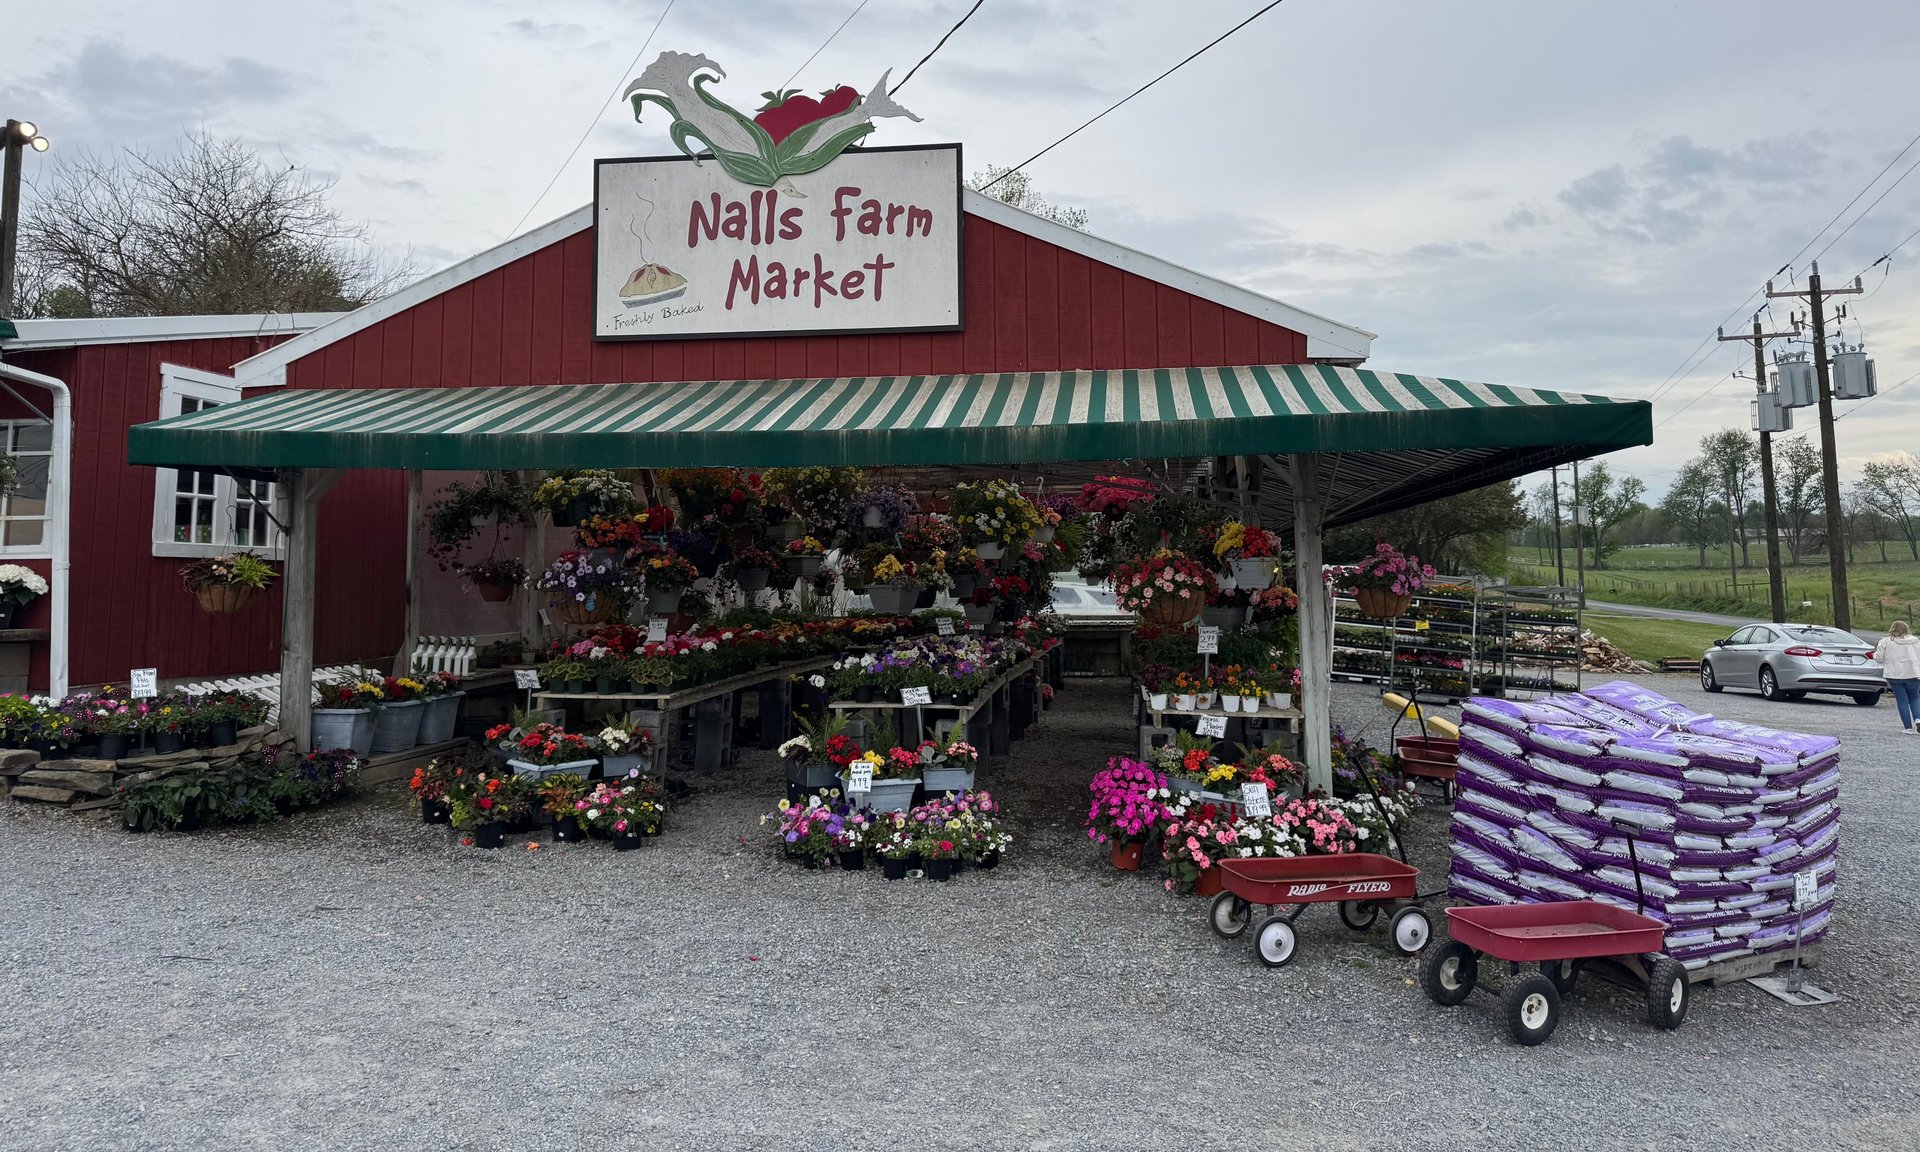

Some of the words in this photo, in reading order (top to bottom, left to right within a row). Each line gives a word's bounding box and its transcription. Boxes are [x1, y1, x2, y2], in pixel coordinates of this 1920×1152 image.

[687, 188, 804, 249] Nalls
[725, 252, 895, 310] Market
[612, 311, 654, 330] Freshly
[661, 300, 704, 319] Baked
[1243, 783, 1260, 794] Sun
[1286, 883, 1327, 897] RADIO
[1346, 881, 1391, 893] FLYER
